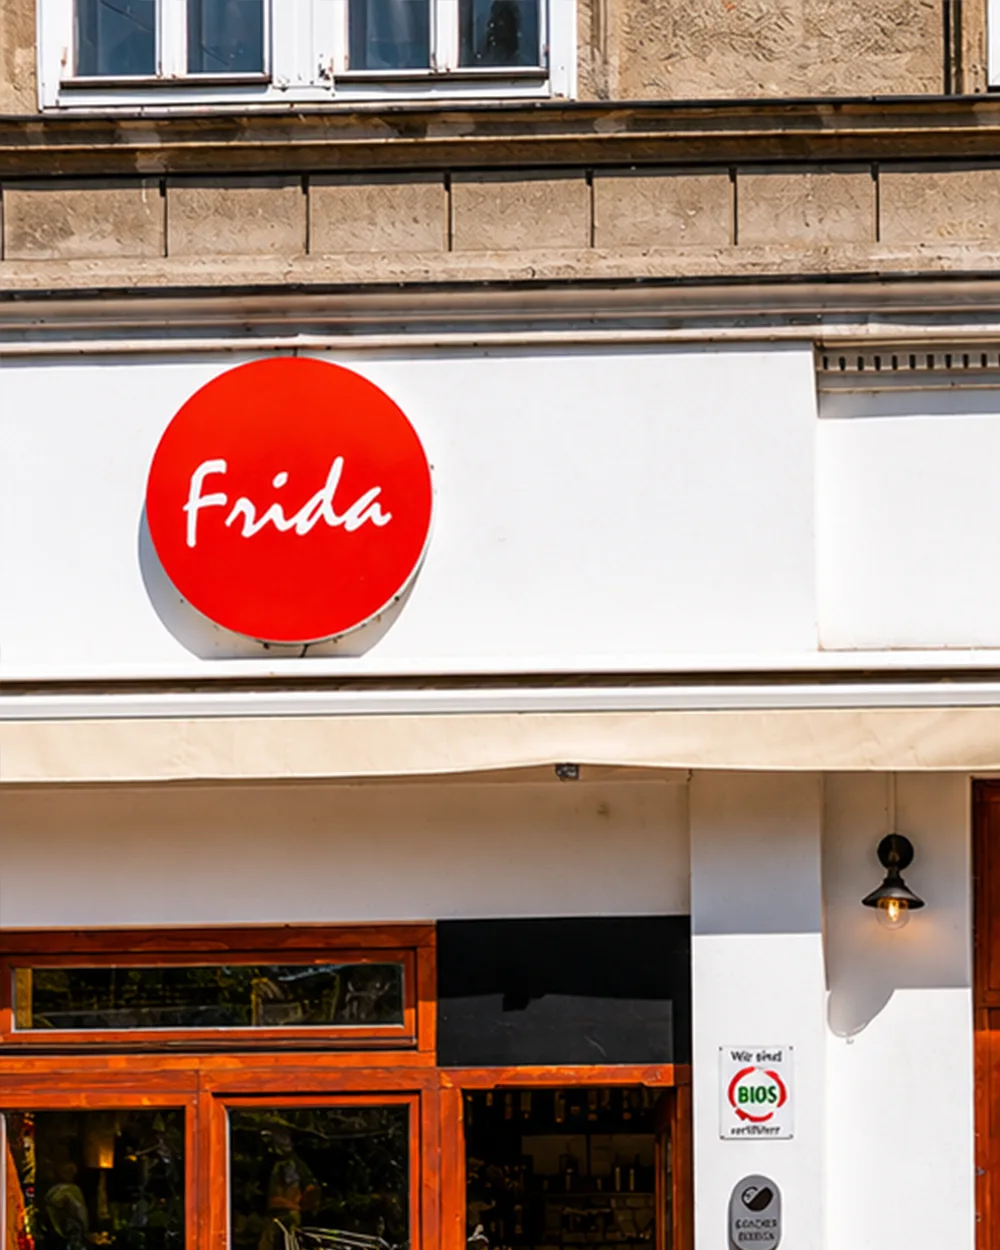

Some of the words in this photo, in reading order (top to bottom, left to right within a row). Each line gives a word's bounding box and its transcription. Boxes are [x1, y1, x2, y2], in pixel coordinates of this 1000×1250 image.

[183, 456, 392, 548] Frida
[730, 1051, 753, 1062] Wir
[738, 1085, 778, 1104] BIOS
